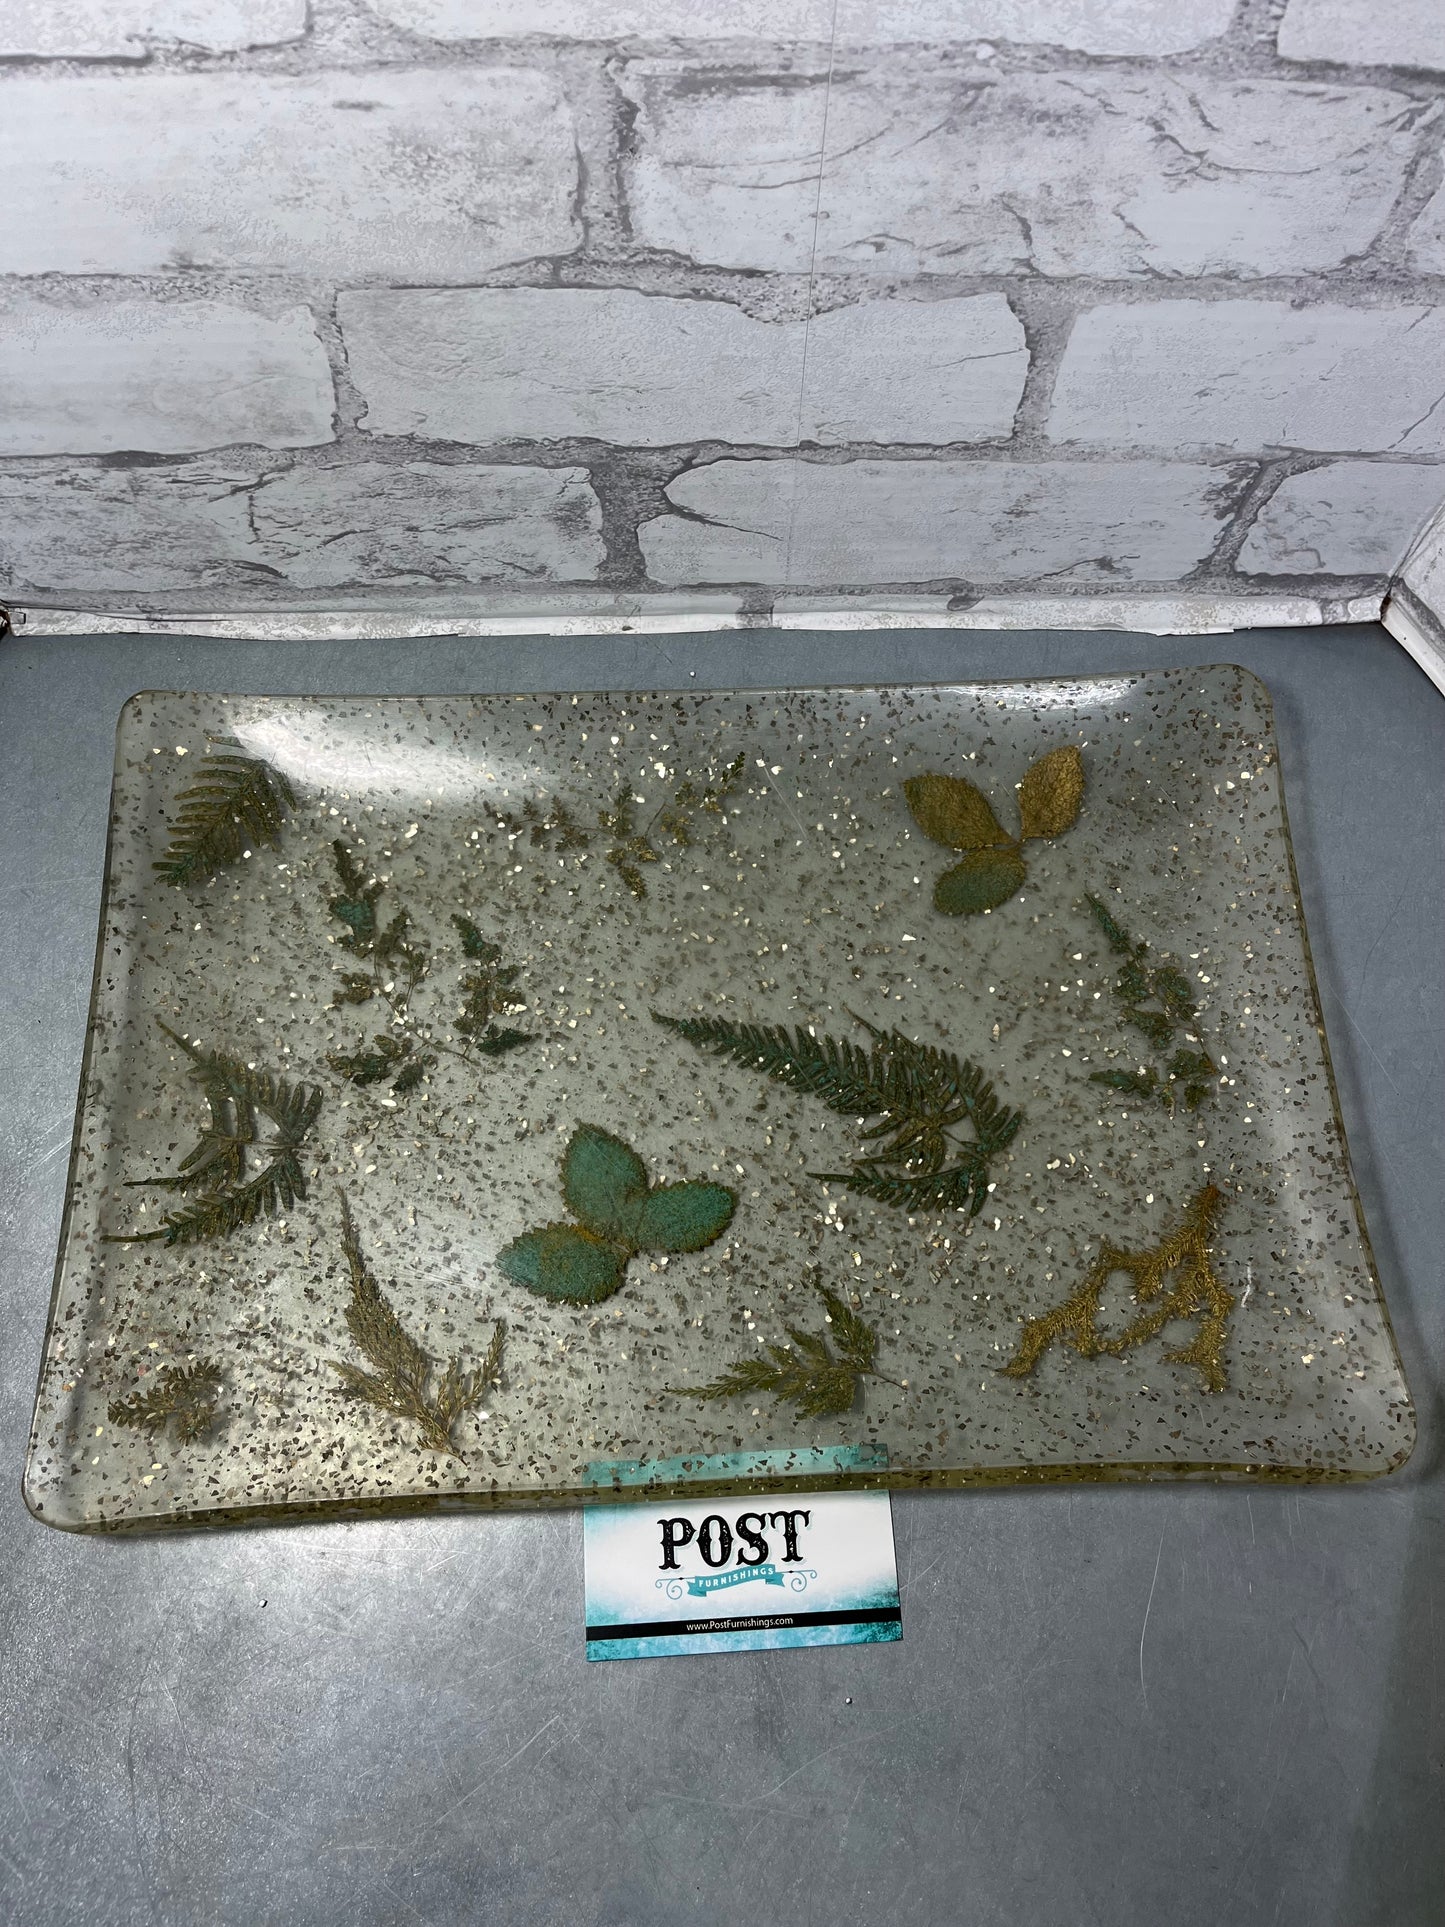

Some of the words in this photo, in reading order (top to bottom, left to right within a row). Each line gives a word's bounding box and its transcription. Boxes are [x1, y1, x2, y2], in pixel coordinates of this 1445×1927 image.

[657, 1510, 811, 1570] POST
[698, 1567, 774, 1588] FURNISHINGS
[686, 1617, 794, 1631] www.PostFurnishings.com
